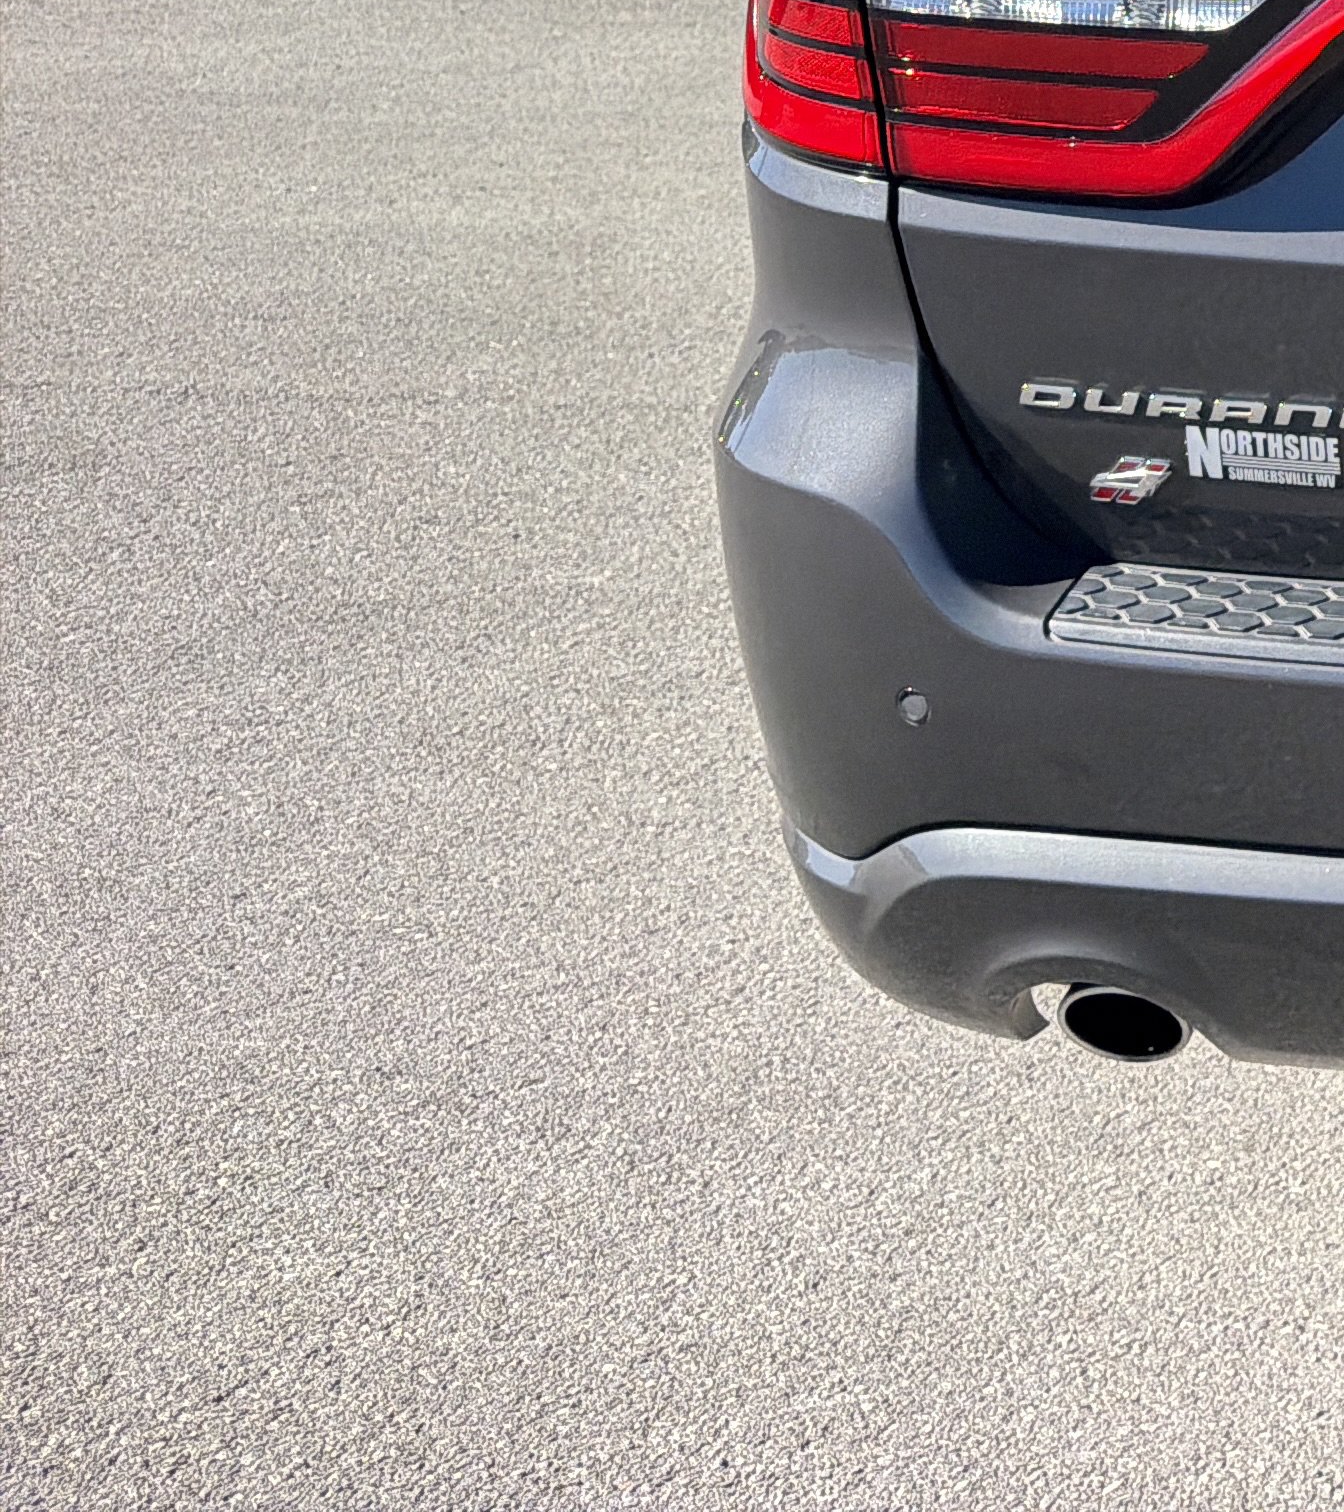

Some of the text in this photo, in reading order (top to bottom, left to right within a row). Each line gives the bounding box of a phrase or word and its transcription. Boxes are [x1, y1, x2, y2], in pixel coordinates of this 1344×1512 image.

[1185, 425, 1341, 479] NORTHSIDE
[1227, 465, 1336, 489] SUMMERSVILLE WV
